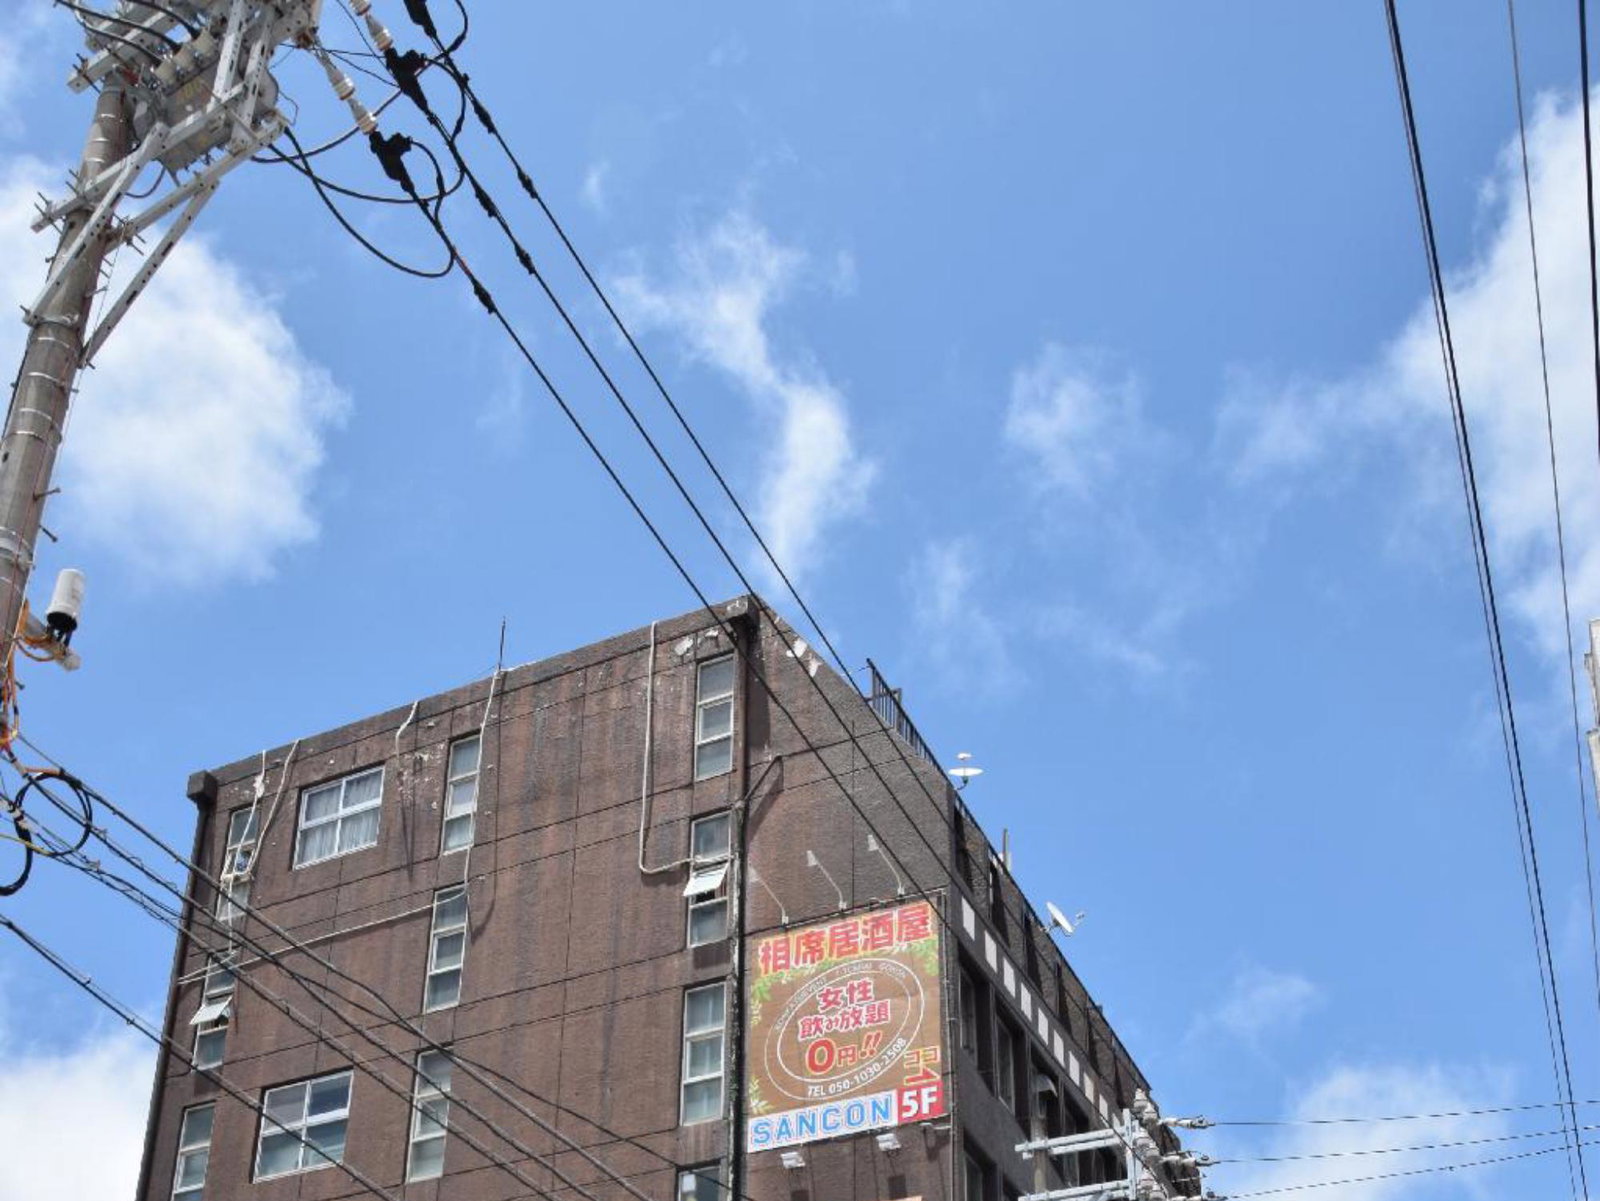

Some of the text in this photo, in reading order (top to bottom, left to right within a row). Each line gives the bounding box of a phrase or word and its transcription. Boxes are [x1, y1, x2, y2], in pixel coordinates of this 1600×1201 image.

[758, 903, 931, 975] 相席居酒屋
[820, 979, 874, 1010] 女性
[799, 1000, 889, 1040] 飲み放題
[807, 1084, 826, 1097] TEL
[752, 1086, 938, 1146] SANCON 5F
